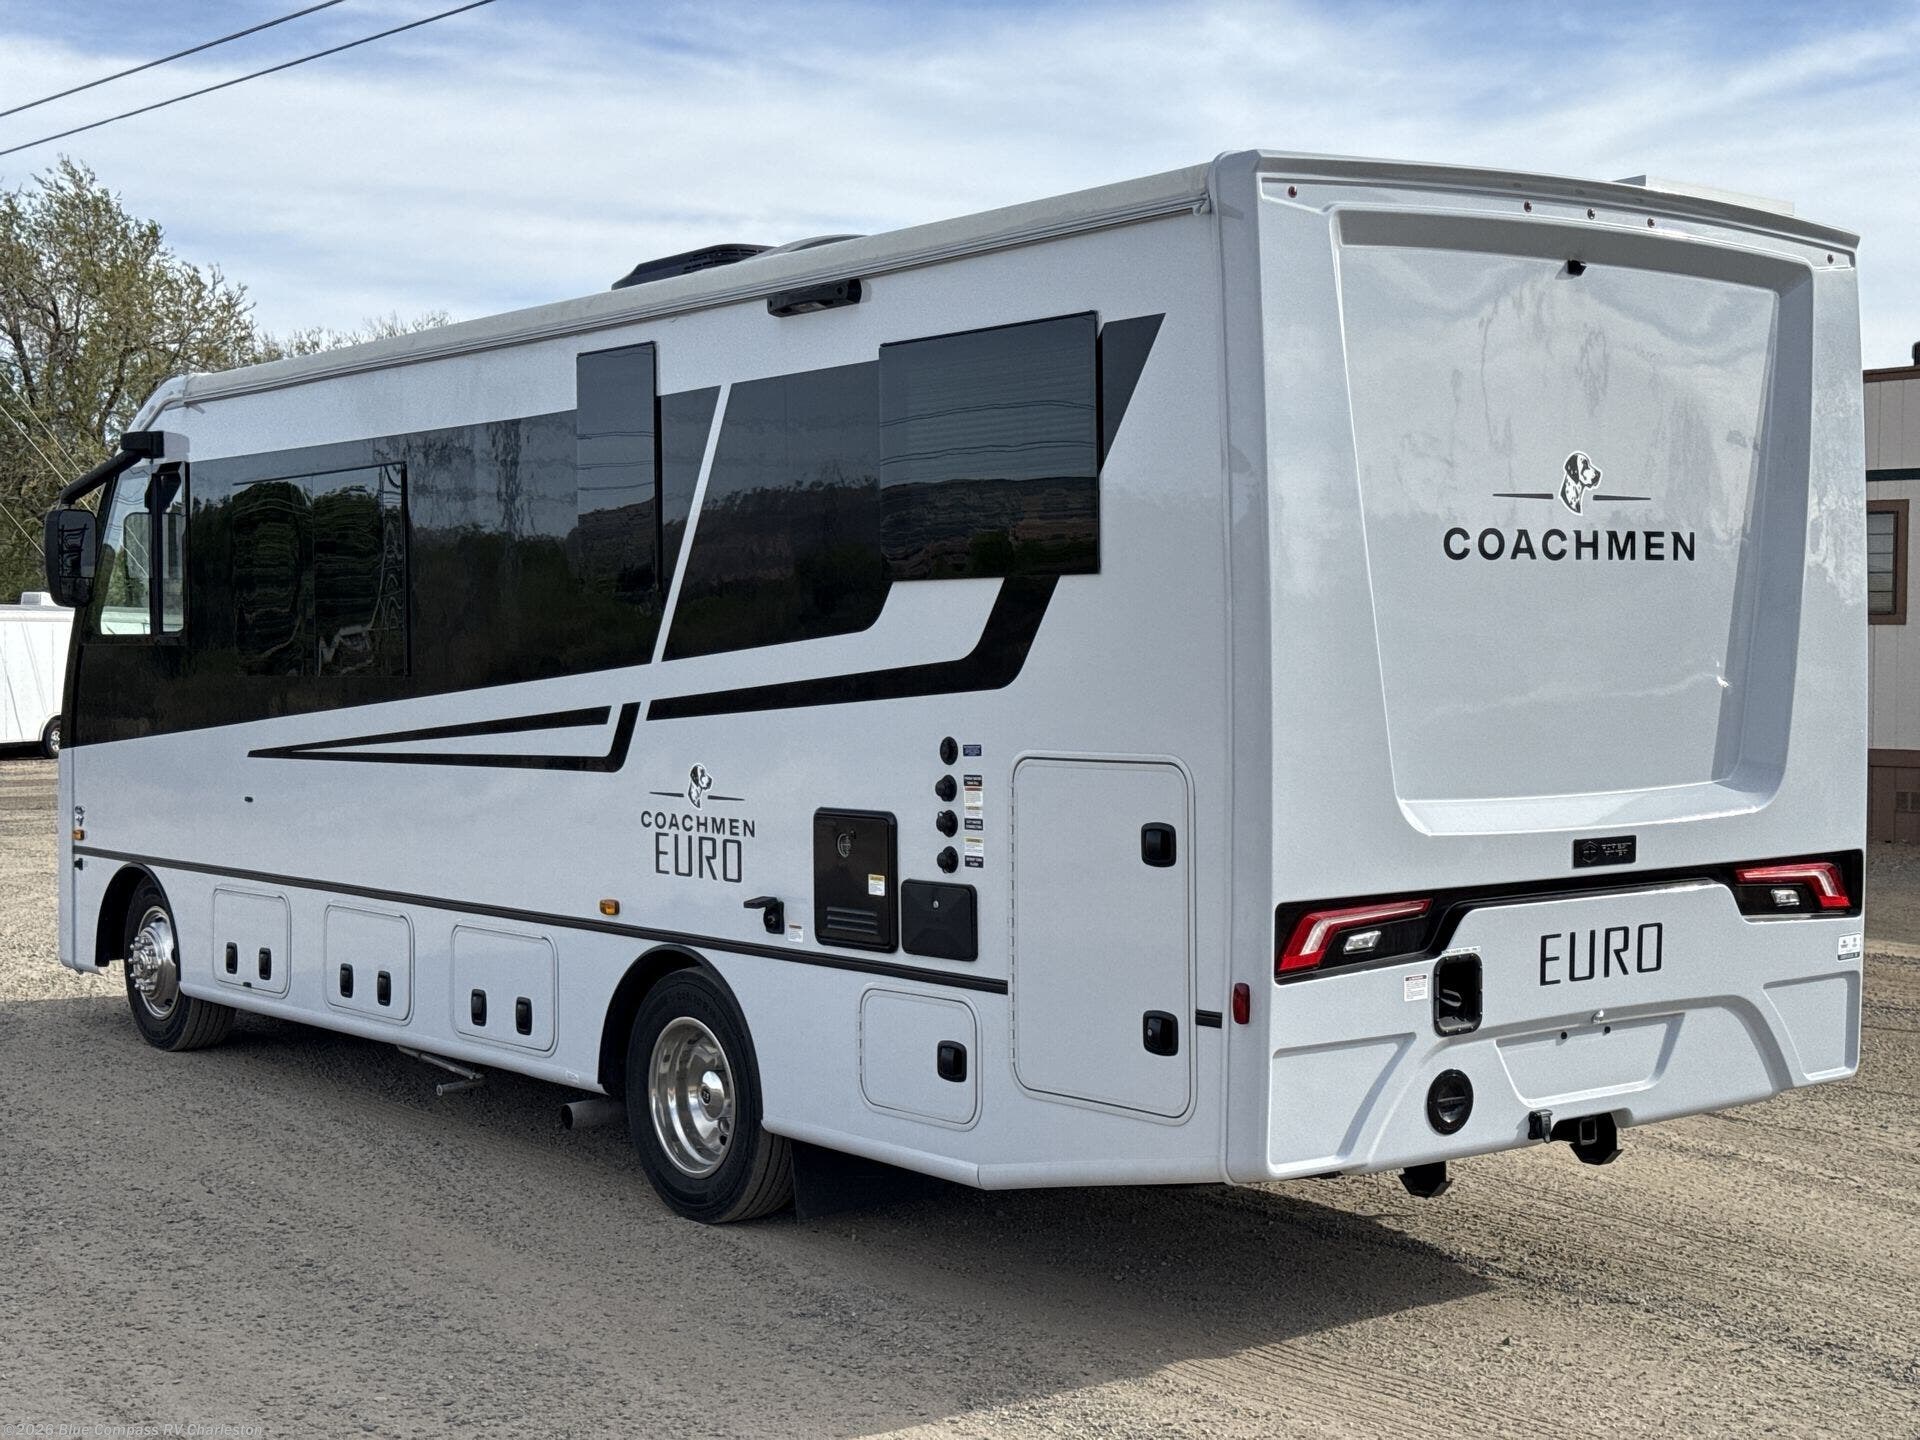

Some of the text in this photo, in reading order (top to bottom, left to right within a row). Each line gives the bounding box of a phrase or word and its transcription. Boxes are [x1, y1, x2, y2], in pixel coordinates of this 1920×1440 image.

[1443, 527, 1695, 561] COACHMEN
[641, 810, 755, 838] COACHMEN
[655, 832, 742, 883] EURO
[1539, 922, 1663, 986] EURO
